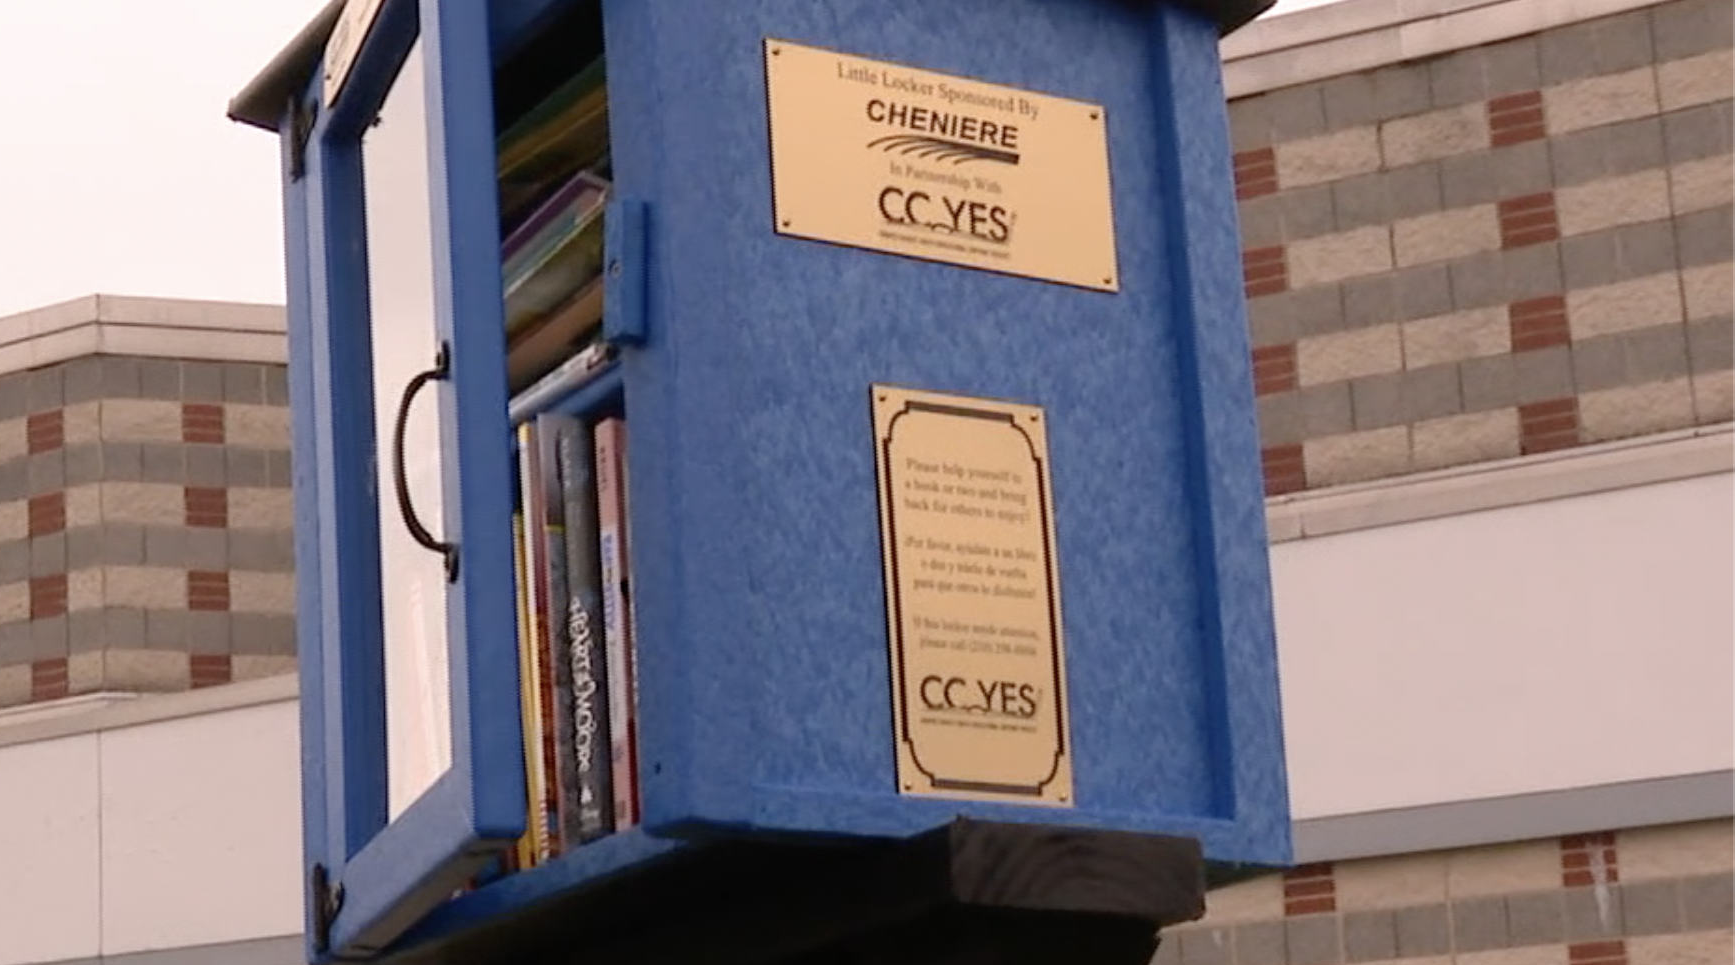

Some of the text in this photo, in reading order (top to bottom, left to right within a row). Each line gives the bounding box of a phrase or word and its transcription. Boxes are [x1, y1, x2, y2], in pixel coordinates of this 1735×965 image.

[837, 62, 1040, 121] Little Locker Sponsored By
[866, 98, 1019, 149] CHENIERE
